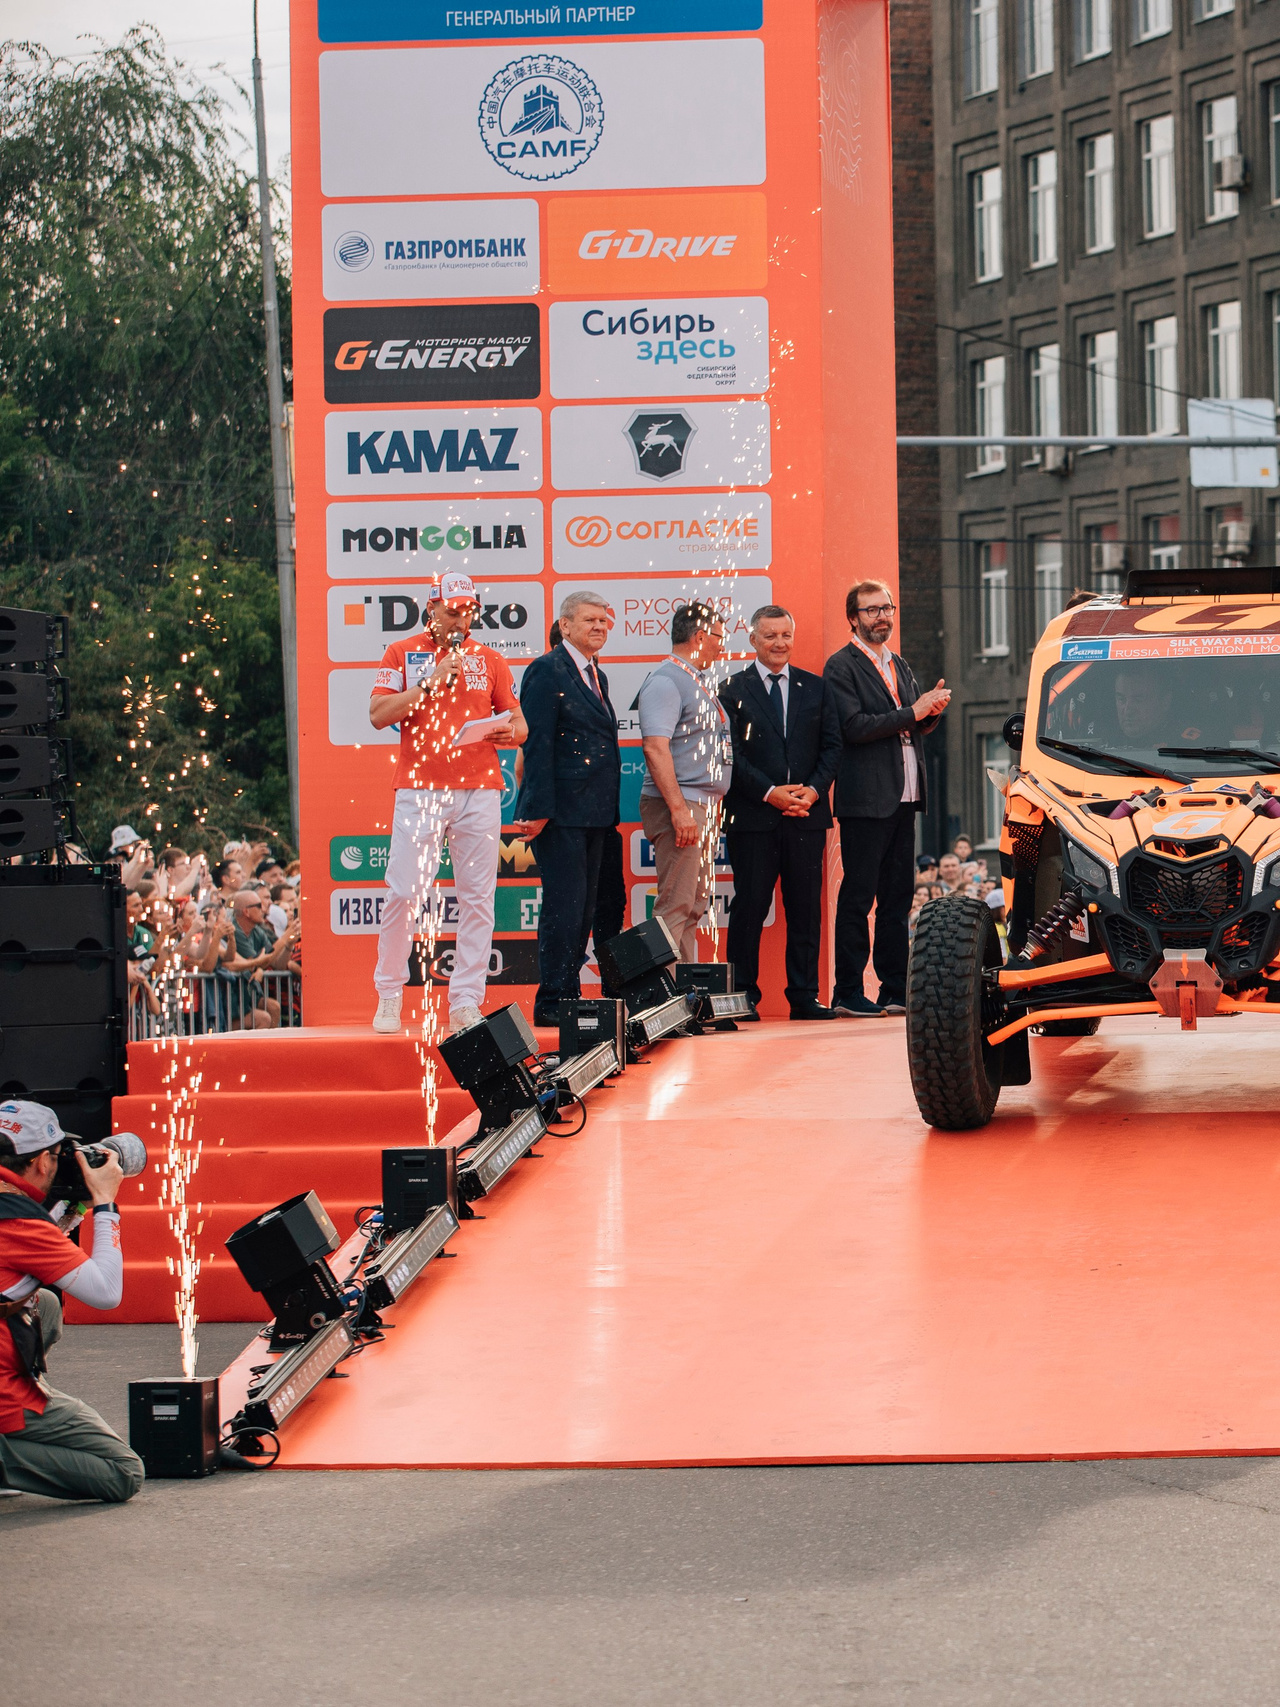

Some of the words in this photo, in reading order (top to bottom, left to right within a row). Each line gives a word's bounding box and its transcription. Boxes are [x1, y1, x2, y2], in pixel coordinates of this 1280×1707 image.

[446, 6, 561, 27] ГЕНЕРАЛЬНЫЙ
[566, 6, 636, 24] ПАРТНЕР
[497, 139, 588, 159] CAMF
[385, 237, 527, 260] ГАЗПРОМБАНК
[384, 262, 438, 271] «Газпромбанк»
[439, 261, 489, 271] (Акционерное
[491, 260, 528, 269] общество)
[582, 308, 716, 340] Сибирь
[415, 337, 486, 348] МОТОРНОЕ
[487, 336, 531, 346] МАСЛО
[637, 339, 735, 365] здесь
[687, 372, 737, 380] ФЕДЕРАЛЬНЫЙ
[347, 427, 520, 475] KAMAZ
[616, 517, 759, 540] СОГЛАСИЕ
[342, 524, 527, 552] MONGOLIA
[678, 541, 759, 554] страхование
[624, 618, 752, 636] МЕХКА
[1115, 649, 1160, 658] RUSSIA
[1173, 647, 1191, 656] 15th
[1194, 645, 1244, 655] EDITION
[1169, 640, 1198, 648] SILK
[1201, 638, 1231, 647] WAY
[1234, 637, 1275, 645] RALLY
[465, 675, 487, 684] SILK
[467, 682, 487, 691] WAY
